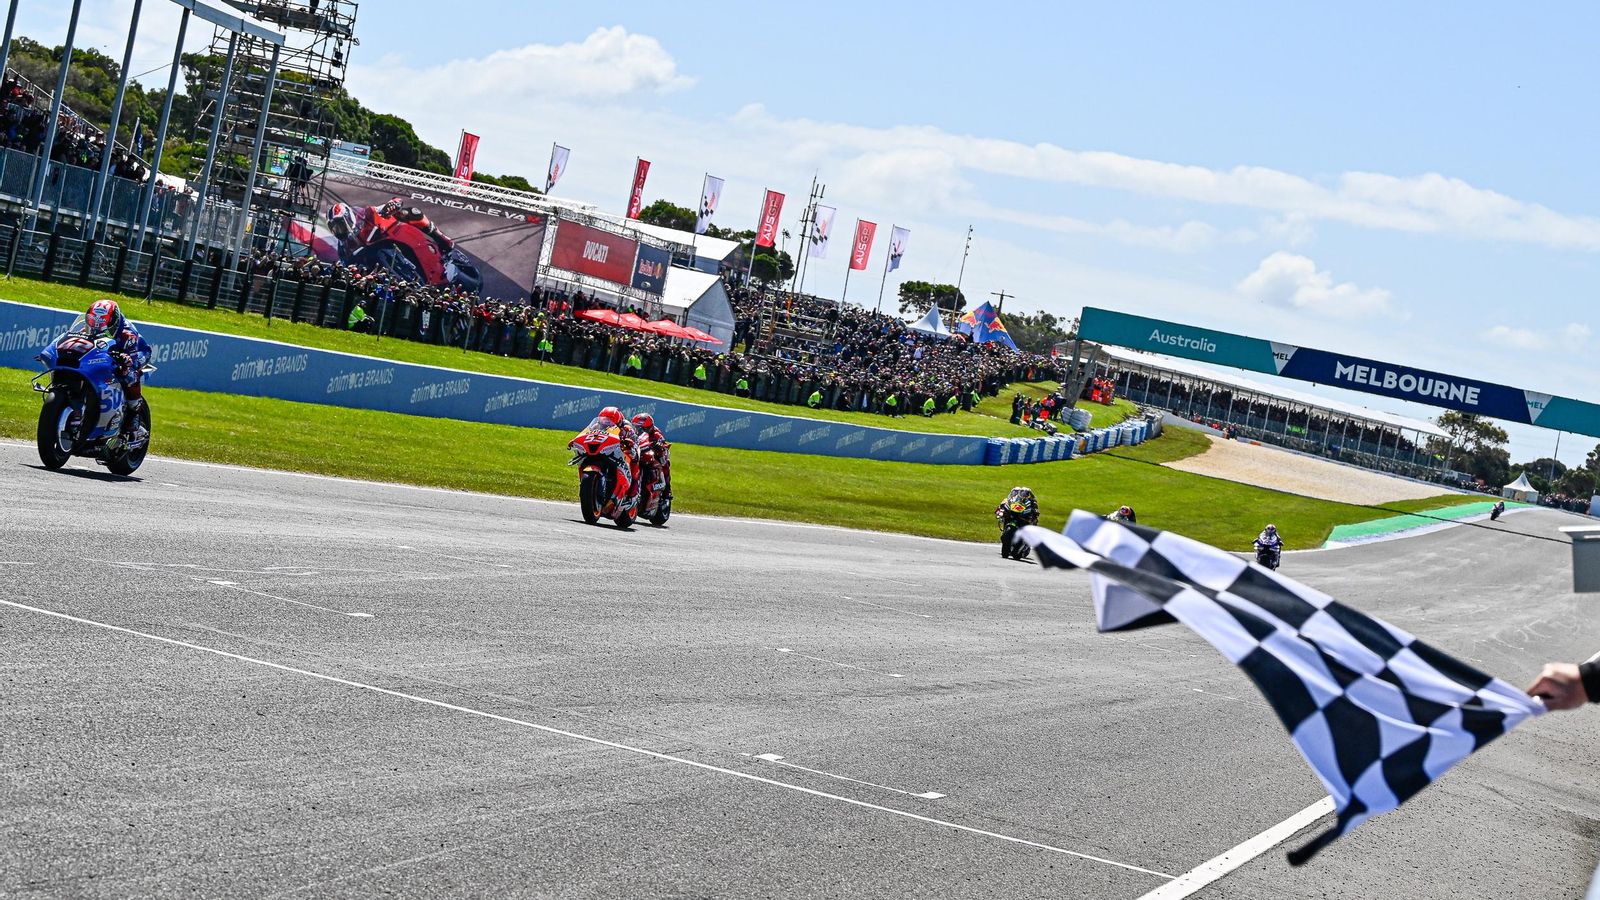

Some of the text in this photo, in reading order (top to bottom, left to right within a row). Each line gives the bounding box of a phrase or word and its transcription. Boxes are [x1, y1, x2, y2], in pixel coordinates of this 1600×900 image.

[410, 192, 502, 217] PANIGALE
[583, 241, 609, 263] DUCATI
[171, 339, 209, 361] BRANDS
[1149, 329, 1216, 354] Australia
[231, 353, 308, 381] animoca BRANDS
[1272, 351, 1289, 361] MEL
[365, 367, 394, 387] BRANDS
[1334, 361, 1481, 406] MELBOURNE
[1527, 400, 1544, 409] MEL
